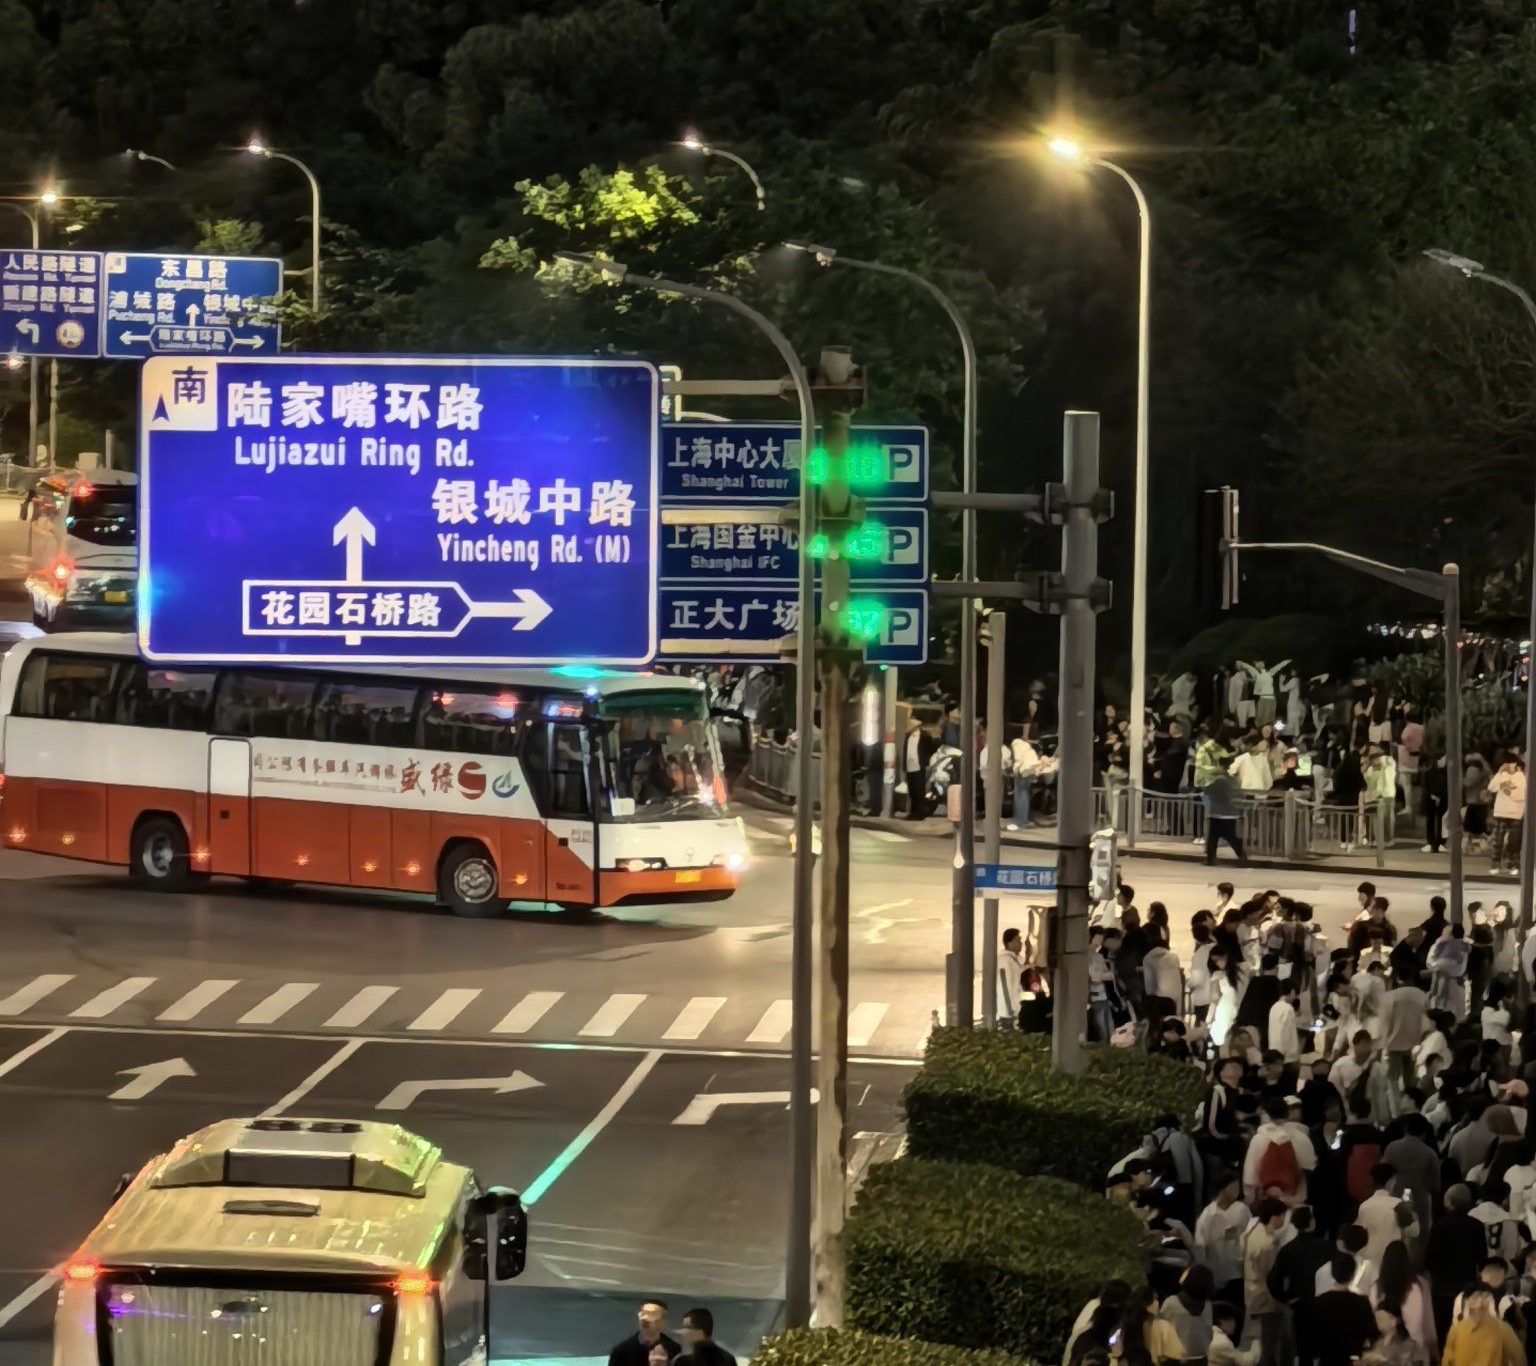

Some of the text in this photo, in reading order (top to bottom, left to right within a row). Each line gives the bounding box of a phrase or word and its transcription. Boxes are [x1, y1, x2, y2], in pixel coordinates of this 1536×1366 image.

[171, 365, 209, 405] 南
[226, 381, 484, 431] 陆家嘴环路
[234, 436, 474, 475] Lujiazui Ring Rd.
[681, 473, 790, 491] Shanghai Tower
[431, 476, 636, 528] 银城中路
[437, 533, 631, 571] Yincheng Rd. (M)
[690, 555, 753, 573] Shanghai
[260, 591, 443, 628] 花园石桥路
[669, 598, 800, 632] 正大广场
